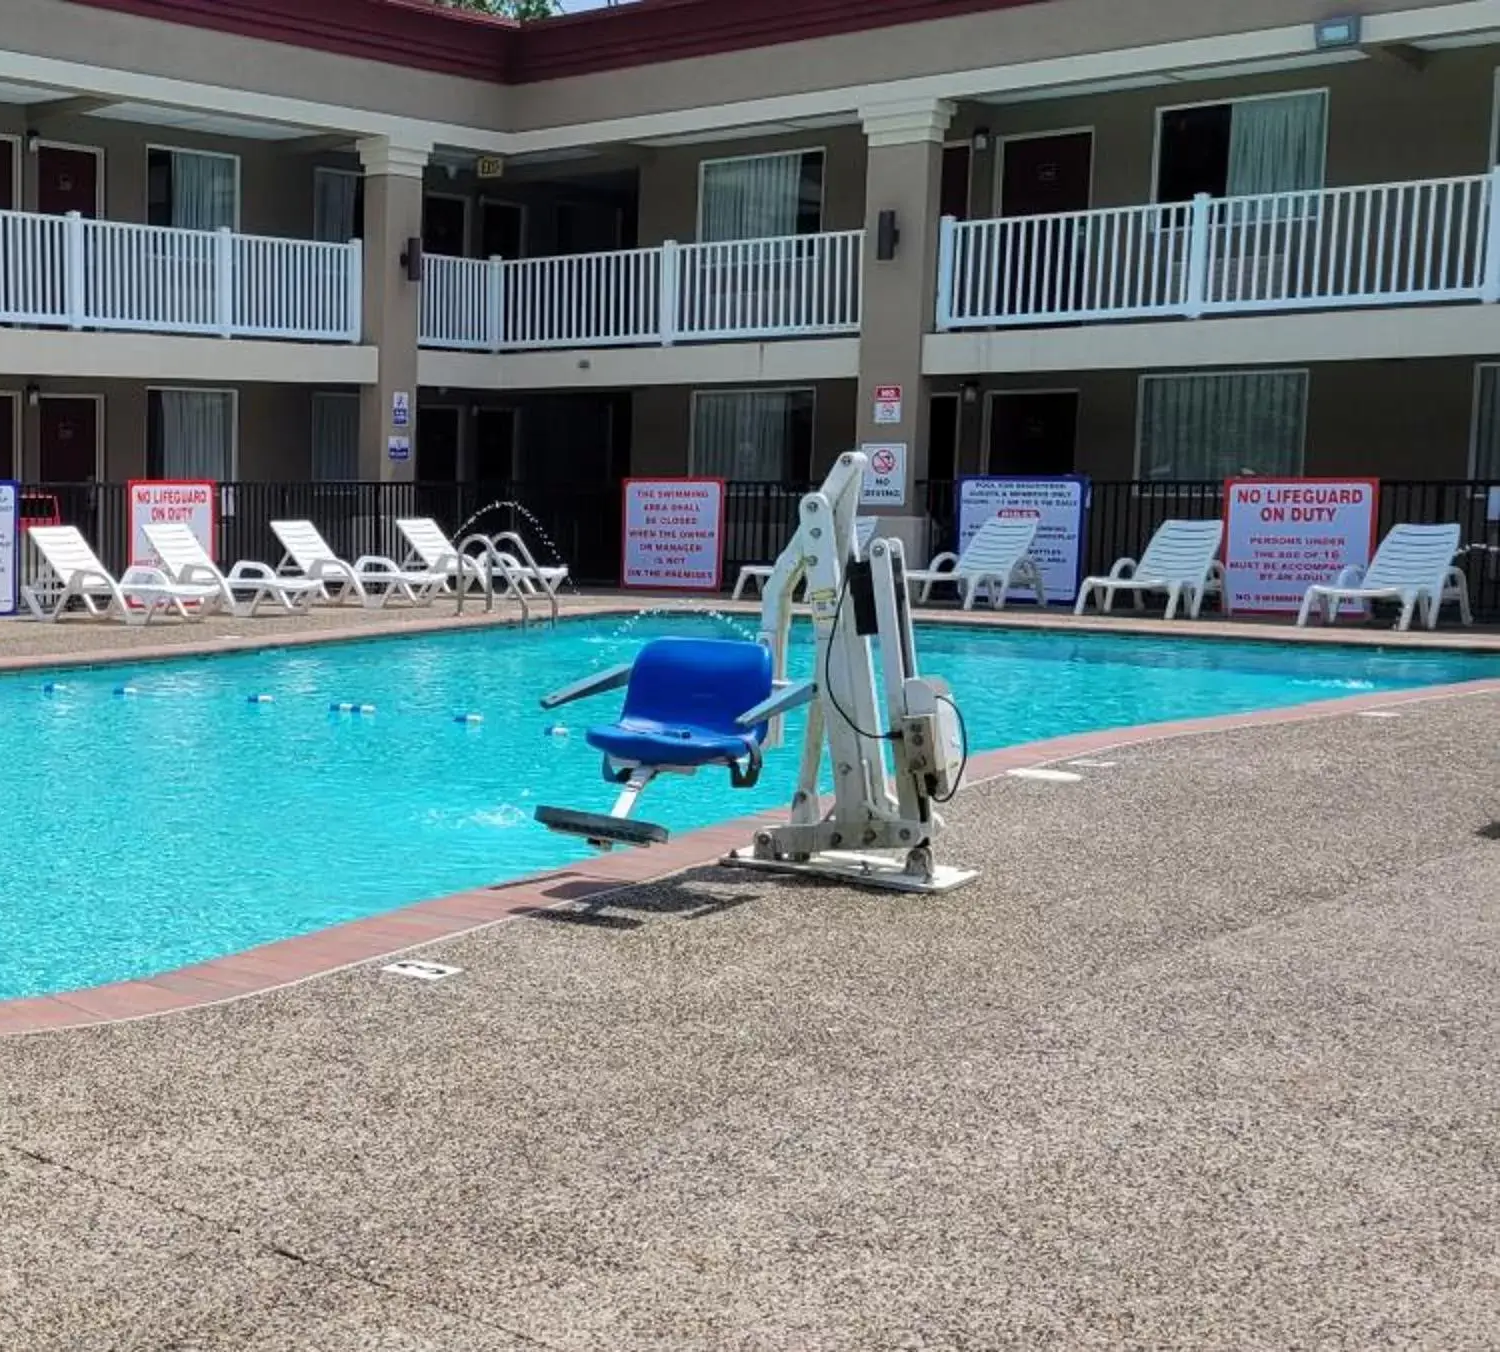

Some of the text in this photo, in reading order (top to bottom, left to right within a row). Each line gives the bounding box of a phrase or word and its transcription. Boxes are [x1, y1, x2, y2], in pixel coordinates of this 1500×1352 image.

[875, 478, 891, 486] NO
[137, 490, 207, 504] NO LIFEGUARD
[637, 489, 709, 498] THE SWIMMING
[1237, 489, 1363, 504] NO LIFEGUARD
[643, 503, 700, 512] AREA SHALL
[151, 507, 193, 520] ON DUTY
[1261, 507, 1337, 521] ON DUTY
[629, 530, 715, 538] WHEN THE OWNER
[1250, 537, 1345, 545] PERSONS UNDER
[640, 543, 703, 552] OR MANAGER
[1254, 551, 1340, 560] THE AGE OF 16
[1264, 562, 1276, 570] BE
[628, 569, 713, 578] ON THE PREMISES
[1255, 593, 1305, 603] SWIMMIN
